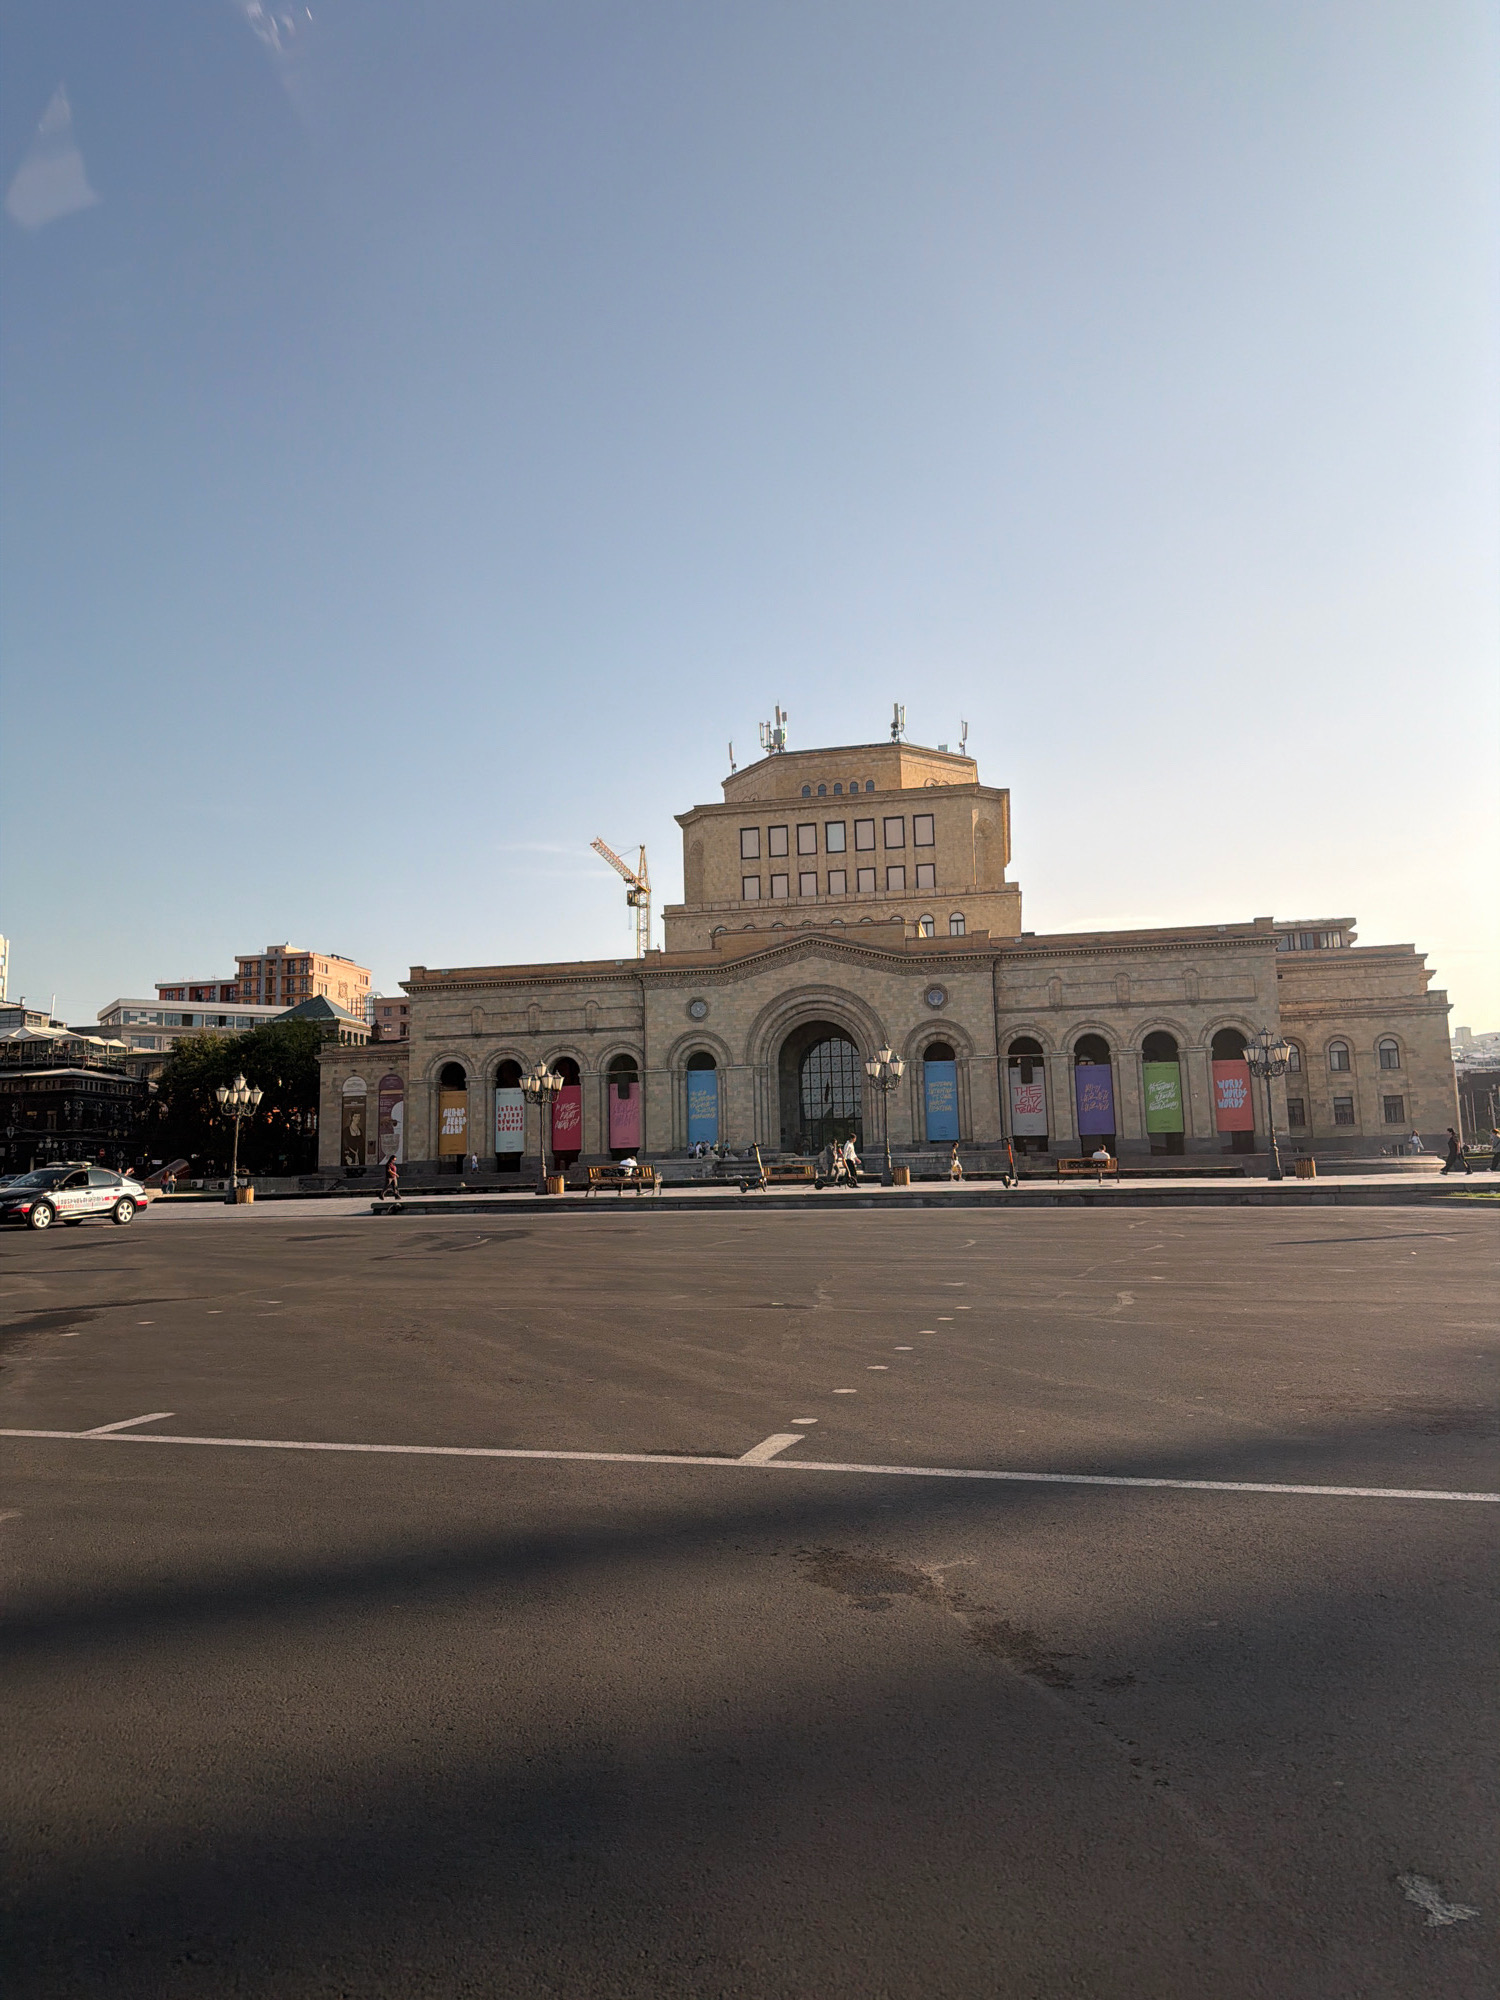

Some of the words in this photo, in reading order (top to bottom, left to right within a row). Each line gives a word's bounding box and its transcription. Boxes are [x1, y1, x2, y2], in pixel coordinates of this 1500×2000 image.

[1217, 1078, 1243, 1088] WORDS
[1013, 1085, 1042, 1096] THE
[1222, 1087, 1247, 1098] WORDS
[1019, 1094, 1042, 1107] CITY
[1217, 1096, 1243, 1108] WORDS
